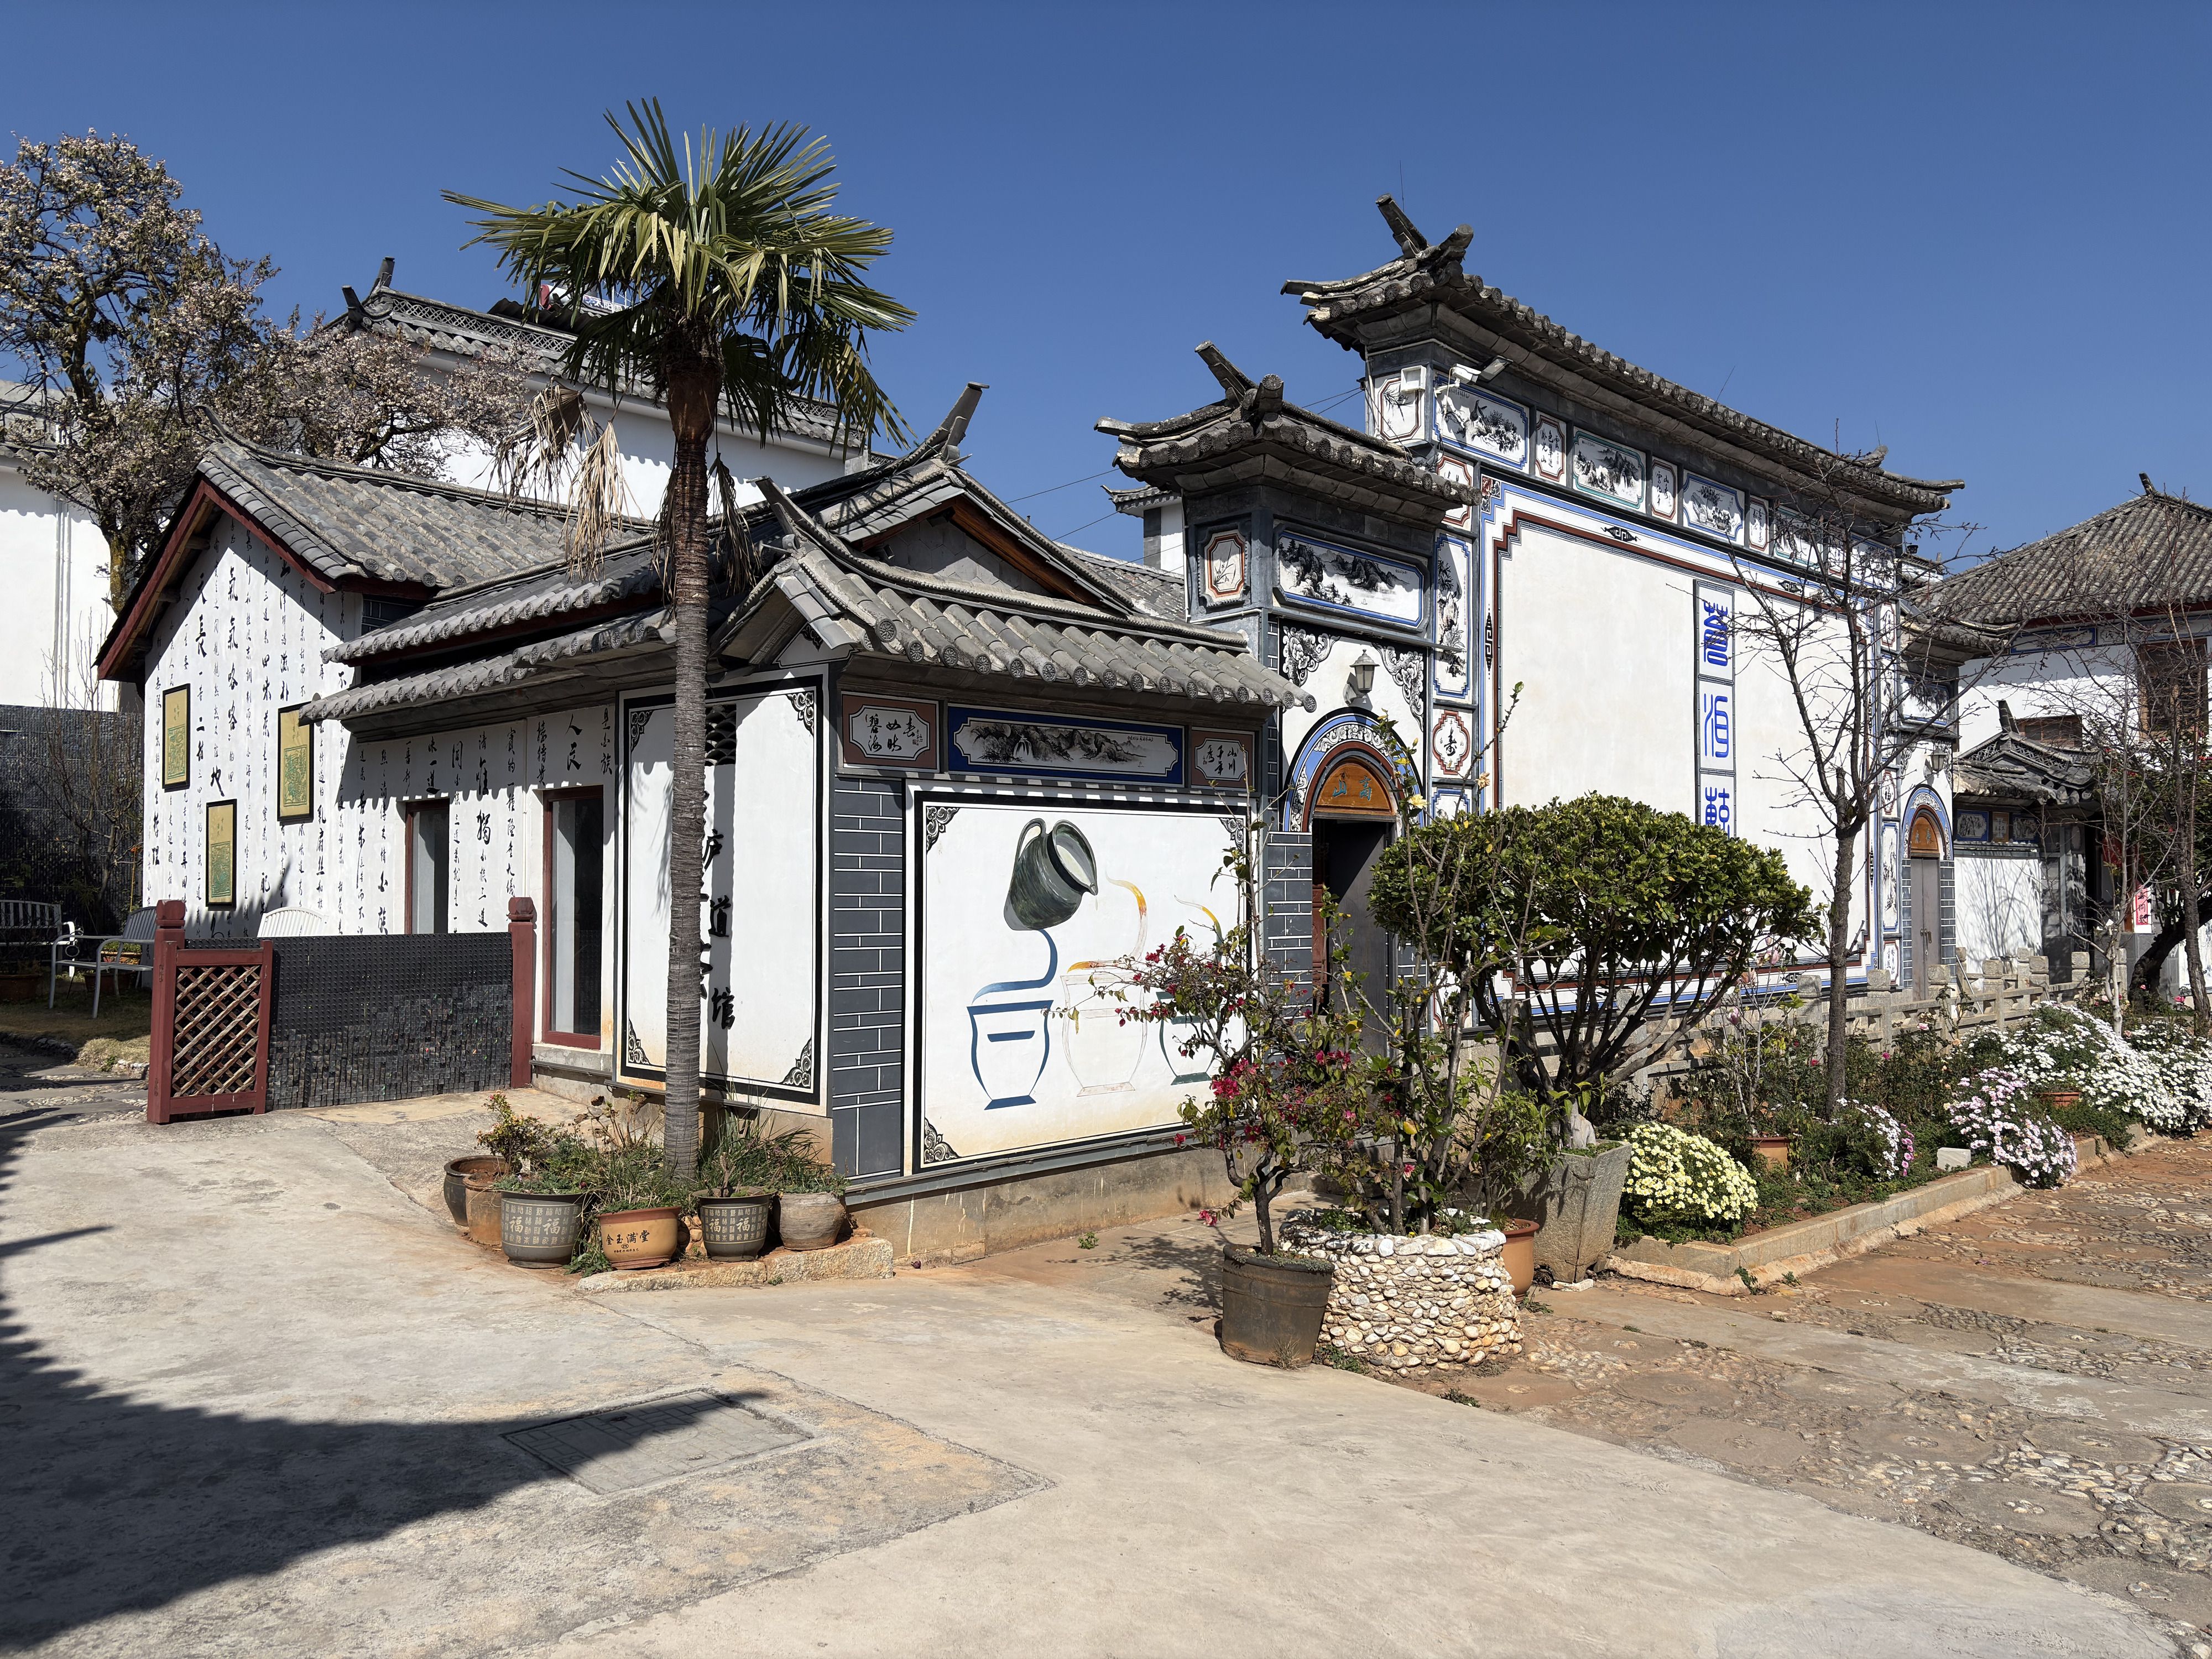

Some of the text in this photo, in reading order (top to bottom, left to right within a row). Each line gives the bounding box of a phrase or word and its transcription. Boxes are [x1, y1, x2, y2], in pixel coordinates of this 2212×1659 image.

[1333, 775, 1373, 801] 高山
[509, 1215, 524, 1234] 福
[542, 1217, 561, 1235] 福
[708, 1218, 722, 1233] 福
[735, 1217, 751, 1233] 福
[606, 1229, 650, 1245] 金玉满堂
